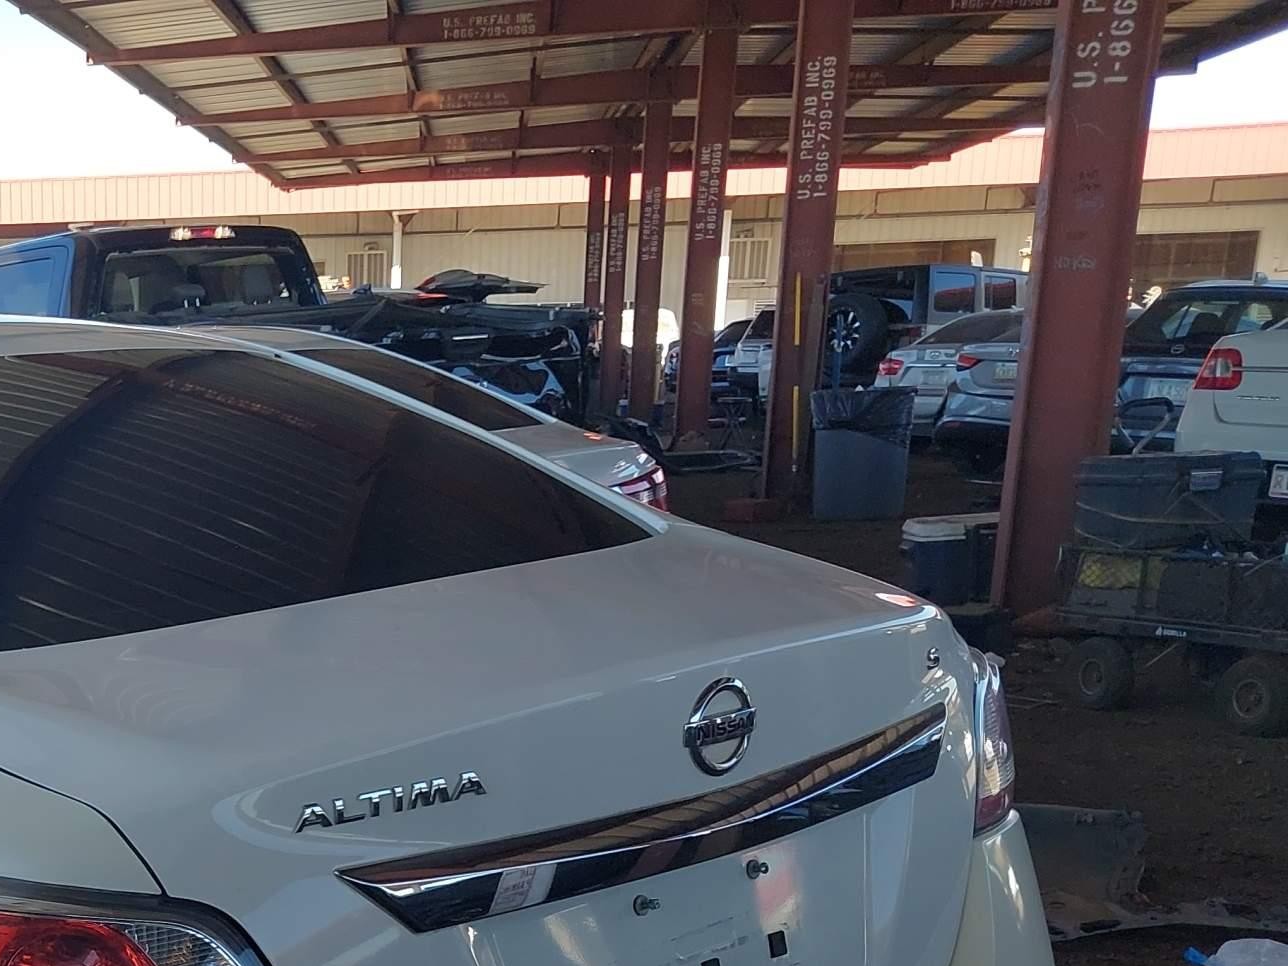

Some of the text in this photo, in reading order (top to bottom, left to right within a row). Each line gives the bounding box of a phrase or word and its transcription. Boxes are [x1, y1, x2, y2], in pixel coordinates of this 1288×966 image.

[1072, 31, 1103, 88] U.S.
[797, 55, 822, 200] U.S. PREFAB INC.
[813, 55, 838, 198] 1-866-799-0969
[696, 710, 753, 747] NISSAN
[293, 770, 487, 834] ALTIMA
